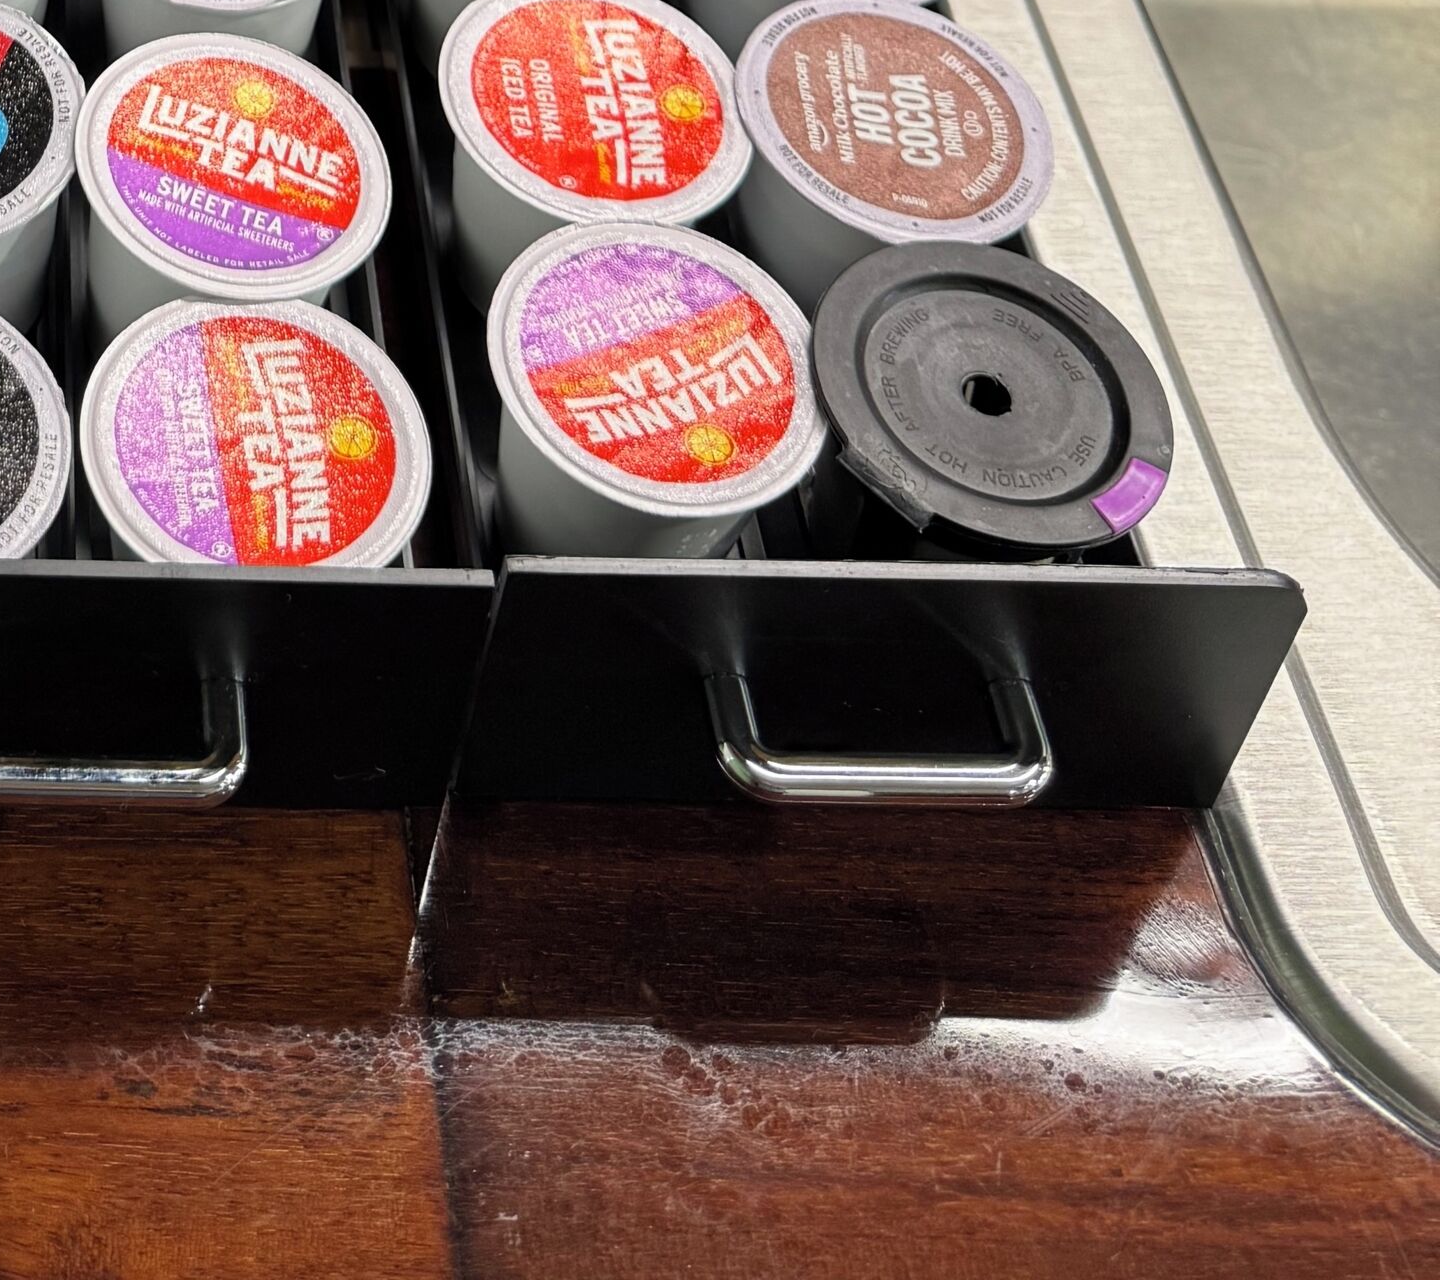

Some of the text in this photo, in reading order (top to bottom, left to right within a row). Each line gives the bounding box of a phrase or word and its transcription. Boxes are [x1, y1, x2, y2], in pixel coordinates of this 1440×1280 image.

[138, 85, 345, 187] LUZIANNE
[499, 57, 534, 139] ICED TEA
[528, 58, 566, 144] ORIGINAL
[580, 70, 626, 141] TEA
[583, 18, 667, 189] LUZIANNE
[802, 94, 829, 153] amazon
[824, 48, 856, 165] Milk Chocolate
[849, 82, 894, 144] HOT
[889, 74, 942, 168] COCOA
[933, 88, 966, 157] DRINK MIX
[190, 137, 280, 190] TEA
[138, 189, 296, 253] MADE WITH ARTIFICIAL SWEETENERS
[156, 176, 236, 216] SWEET
[241, 205, 283, 236] TEA
[564, 317, 606, 348] TEA
[992, 309, 1087, 382] BPA FREE
[571, 332, 782, 445] LUZIANNE
[609, 348, 705, 400] TEA
[880, 308, 1097, 489] USE CAUTION HOT AFTER BREWING
[237, 406, 287, 492] TEA
[241, 338, 332, 552] LUZIANNE
